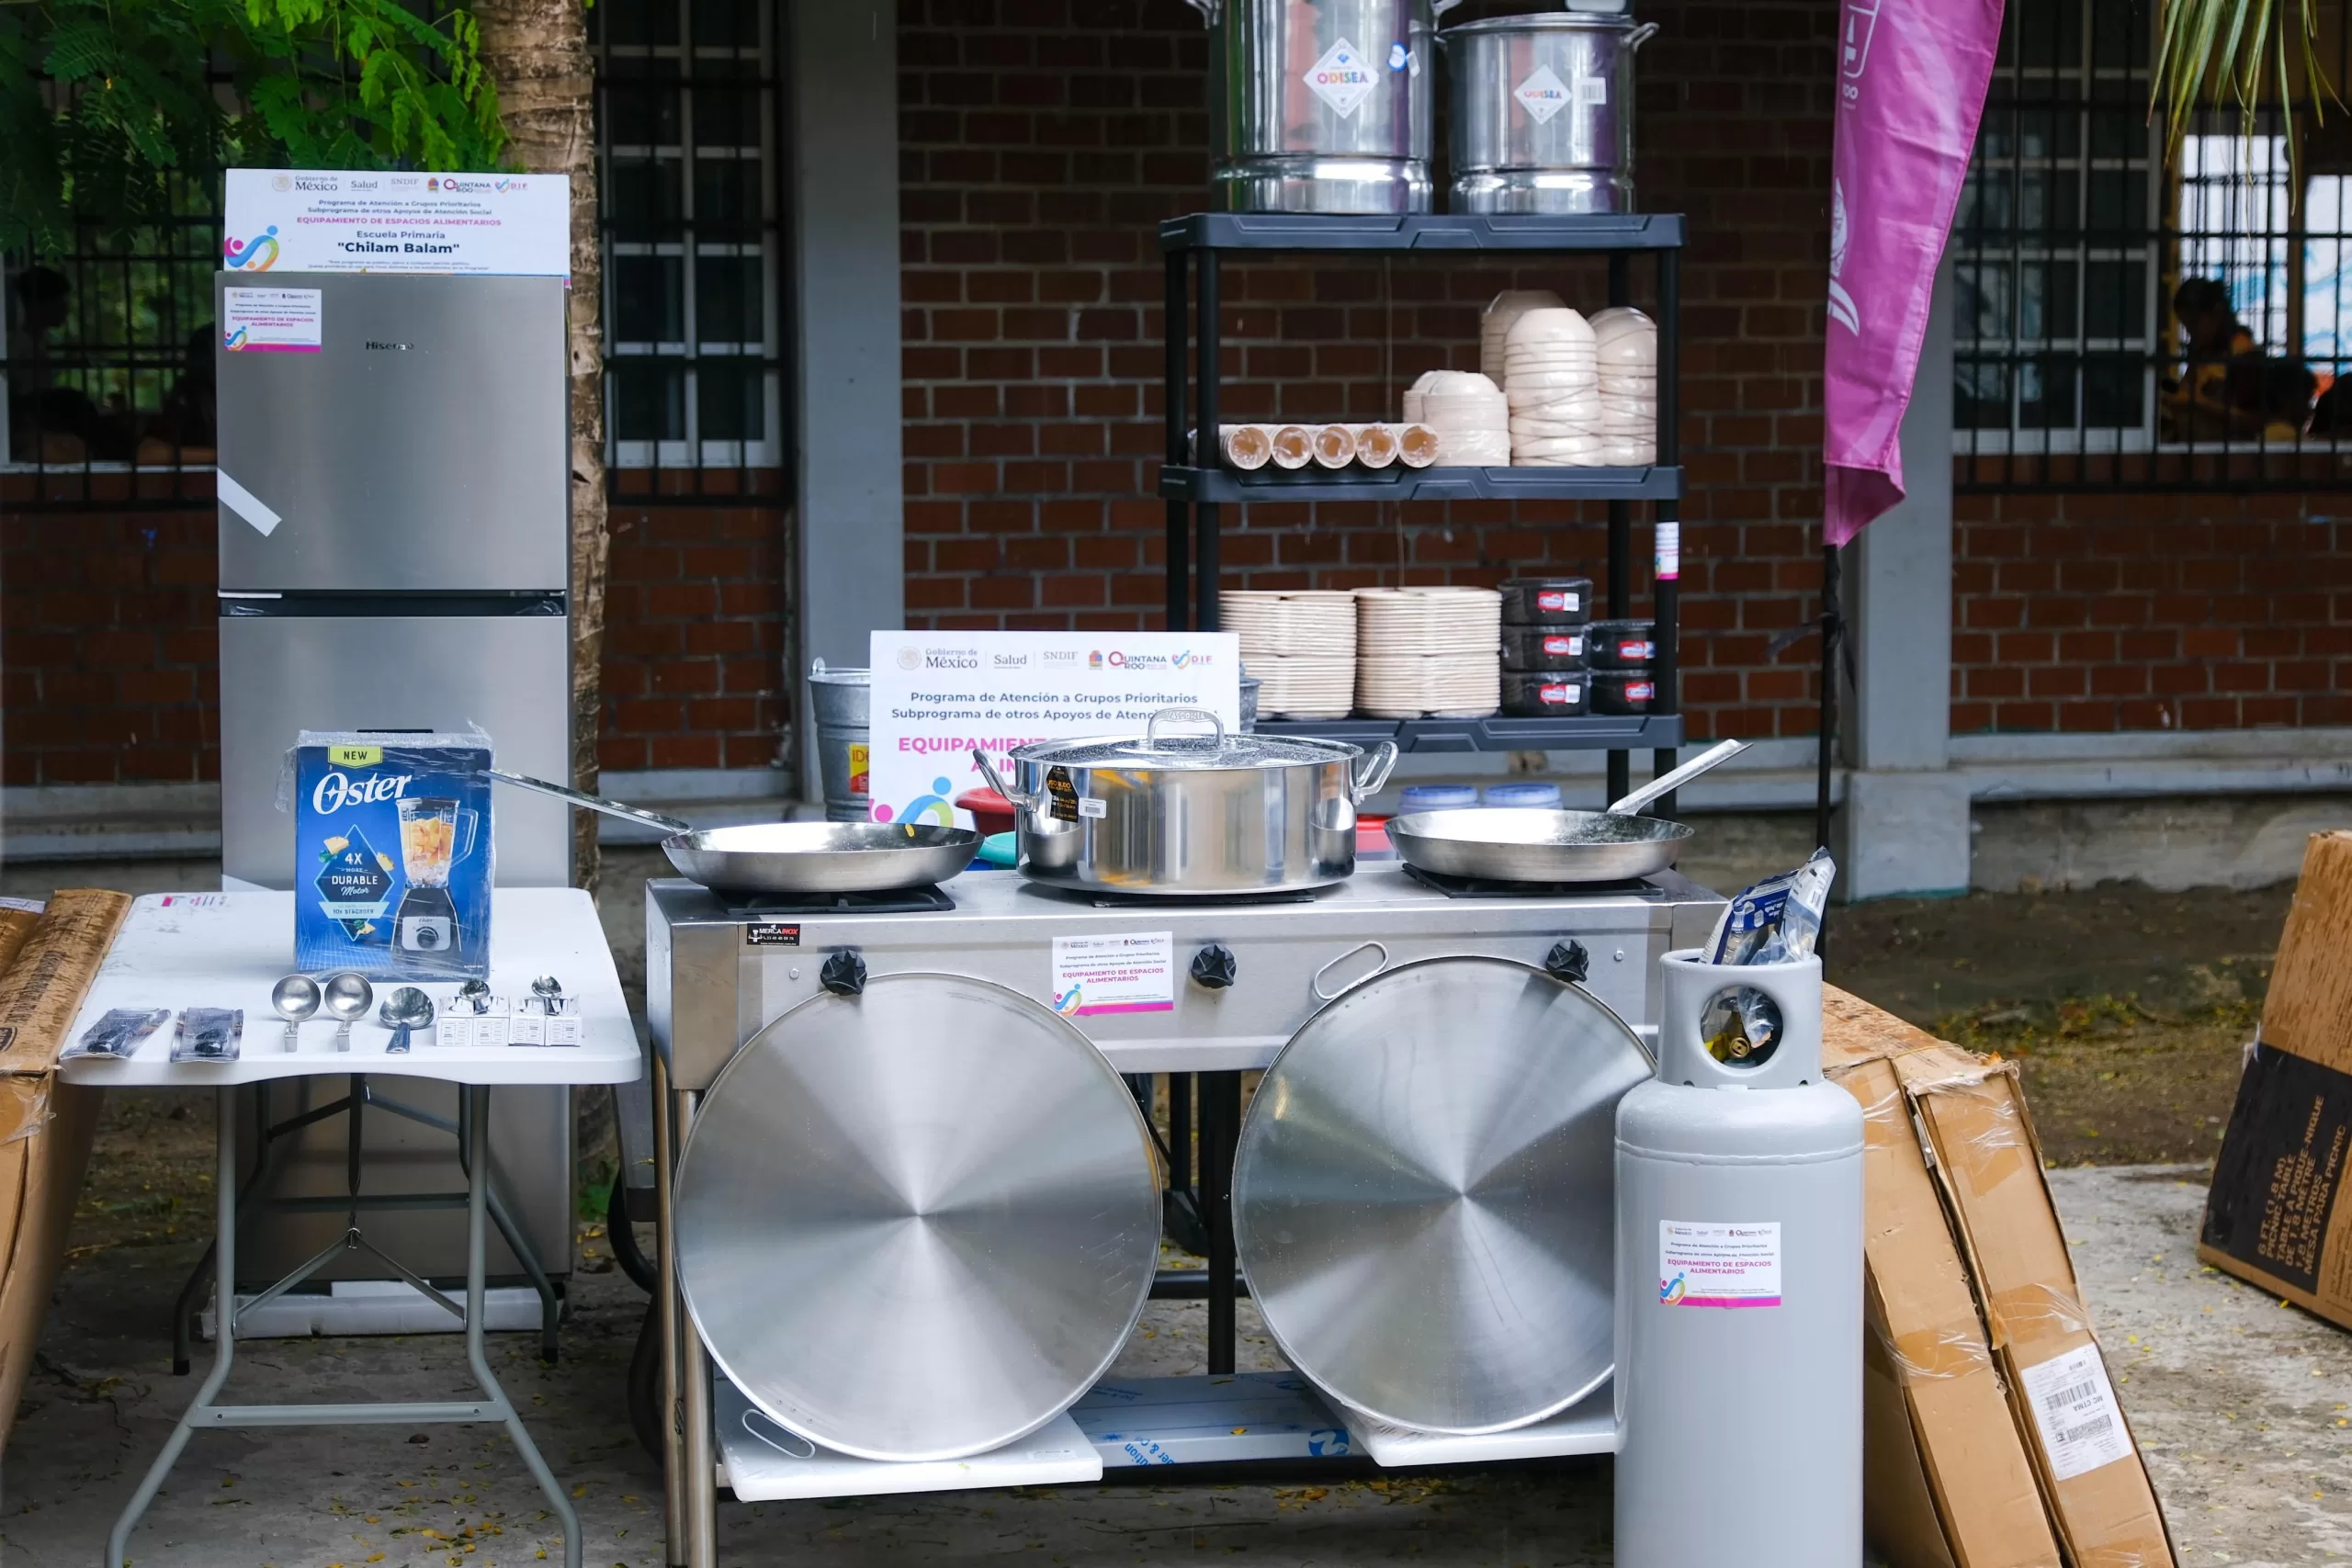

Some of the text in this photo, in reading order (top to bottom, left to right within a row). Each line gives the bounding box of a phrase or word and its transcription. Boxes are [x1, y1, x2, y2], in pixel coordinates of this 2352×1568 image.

[1317, 72, 1369, 84] ODISEA
[295, 181, 338, 191] México
[351, 180, 378, 189] Salud
[444, 178, 491, 190] QUINTANA
[357, 231, 446, 239] Escuela Primaria
[338, 242, 460, 254] "Chilam Balam"
[994, 654, 1027, 665] Salud
[1043, 651, 1079, 660] SNDIF
[1108, 651, 1167, 666] QUINTANA
[1191, 655, 1213, 665] DIF
[925, 655, 978, 669] México
[910, 692, 975, 704] Programa
[980, 692, 996, 702] de
[1000, 691, 1059, 703] Atención
[1074, 694, 1121, 705] Grupos
[1125, 693, 1198, 704] Prioritarios
[892, 708, 1154, 721] Subprograma de otros Apoyos de Atenc
[343, 750, 368, 760] NEW
[313, 772, 413, 815] Oster
[345, 852, 363, 865] 4X
[331, 875, 378, 885] DURABLE
[340, 886, 370, 897] Motor
[1063, 970, 1116, 978] EQUIPAMIENTO
[1086, 976, 1139, 984] ALIMENTARIOS
[2277, 1214, 2291, 1261] TABLE
[2290, 1094, 2325, 1196] PIQUE-NIQUE
[2304, 1123, 2346, 1275] MESA PARA PICNIC
[2267, 1154, 2296, 1258] PICNIC TABLE
[2301, 1173, 2323, 1240] METROS
[2258, 1243, 2267, 1256] 6
[2285, 1244, 2295, 1267] DE
[1668, 1258, 1721, 1267] EQUIPAMIENTO
